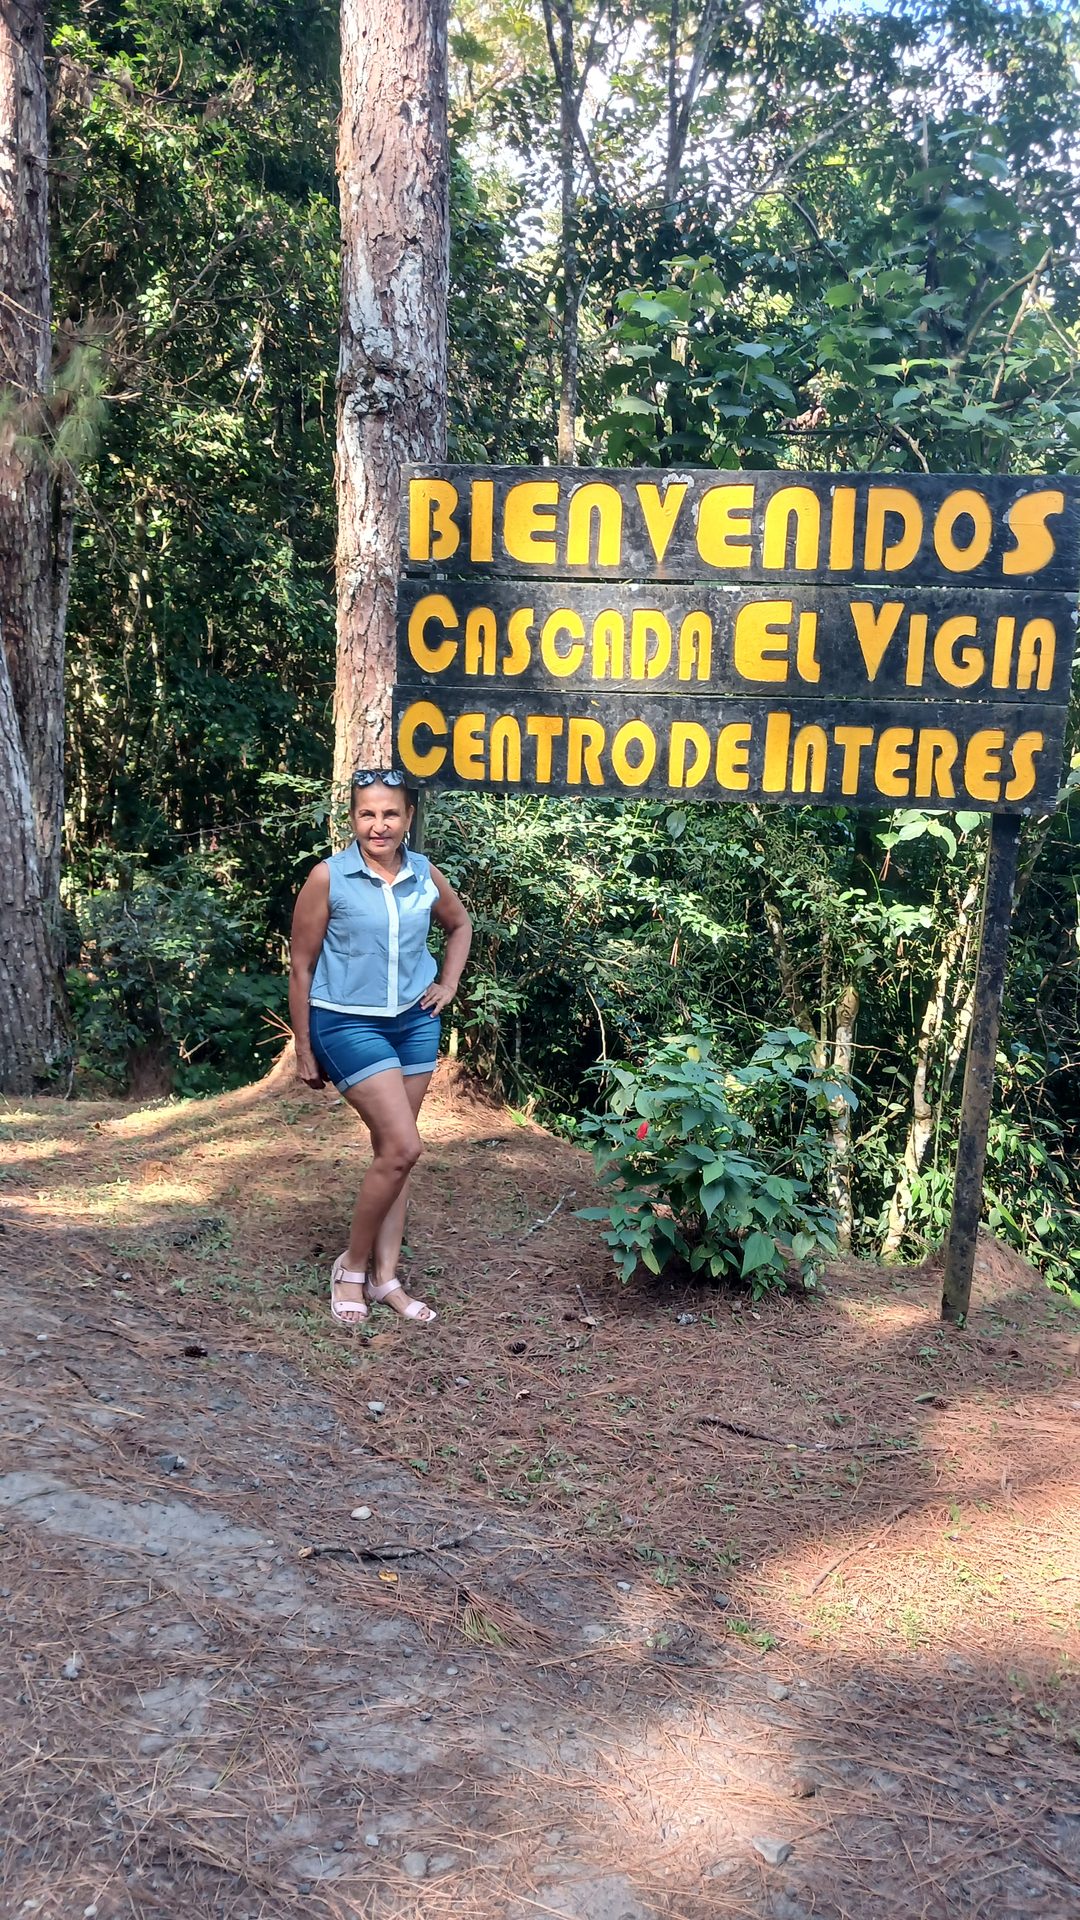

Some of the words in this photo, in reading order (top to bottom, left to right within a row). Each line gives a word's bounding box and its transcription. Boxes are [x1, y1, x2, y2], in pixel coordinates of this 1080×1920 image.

[408, 478, 1065, 575] BIENVENIDOS
[408, 593, 712, 681] CASCADA
[734, 600, 821, 683] EL
[849, 602, 1056, 691] VIGIA
[397, 700, 656, 787] CENTRO
[668, 721, 752, 791] DE
[762, 711, 1044, 802] INTERES
